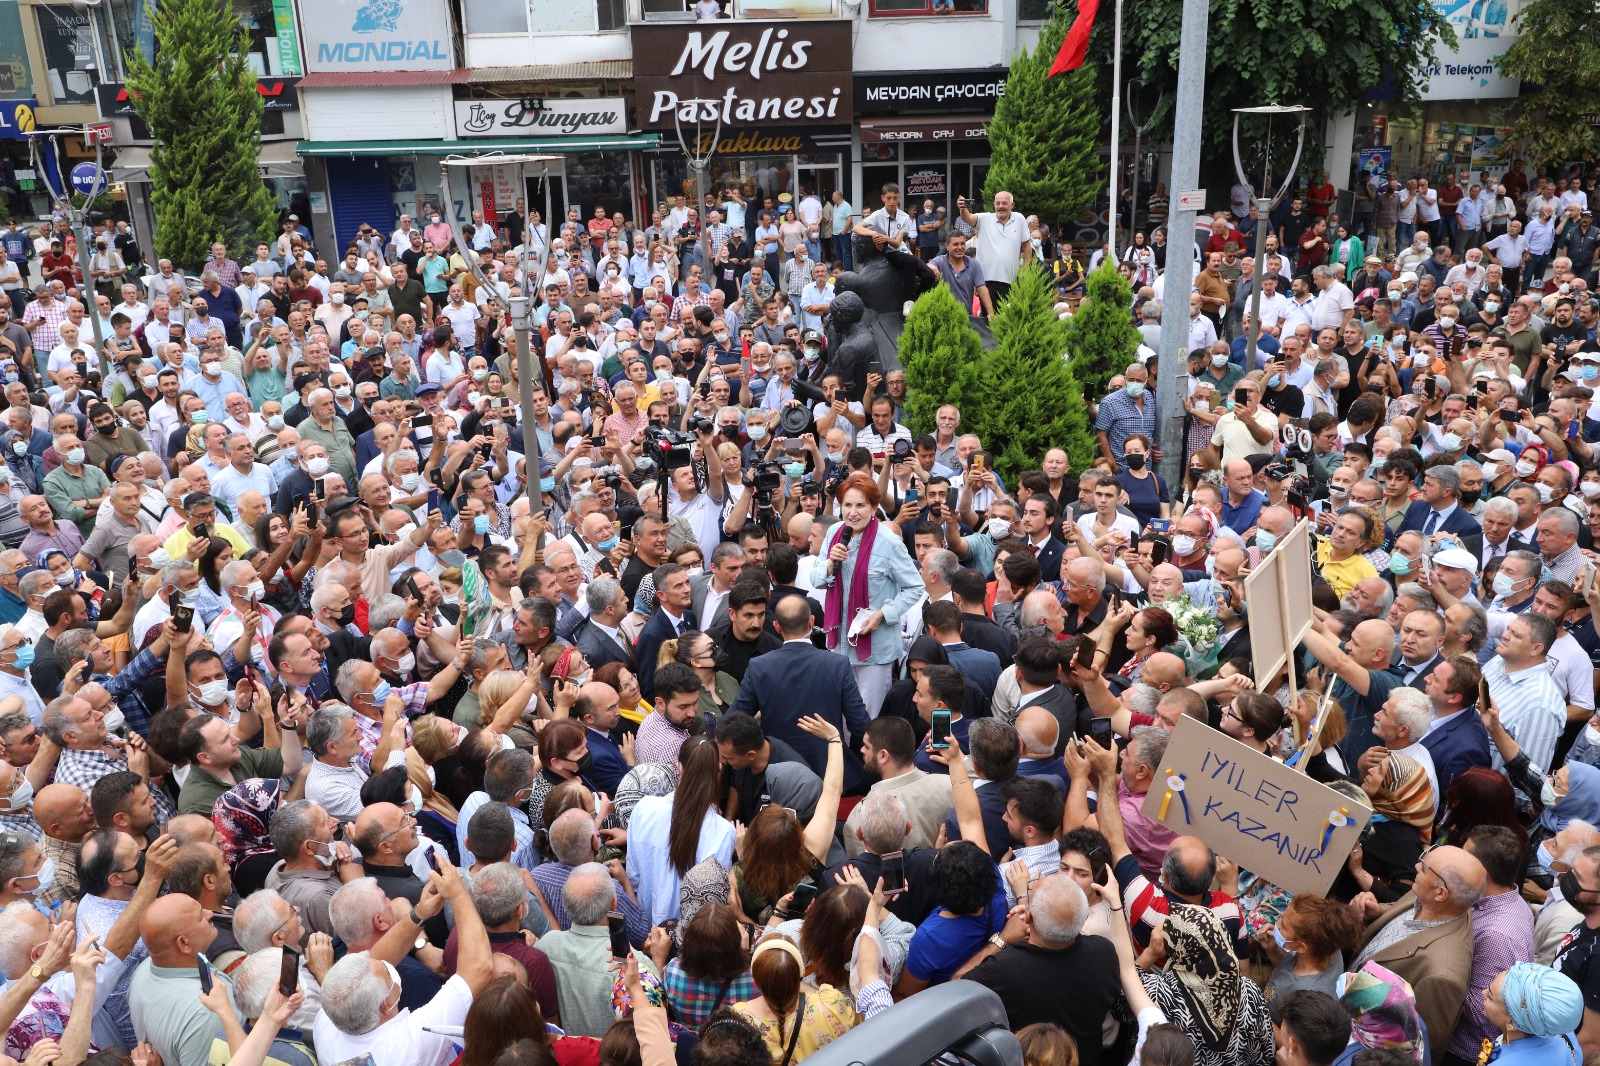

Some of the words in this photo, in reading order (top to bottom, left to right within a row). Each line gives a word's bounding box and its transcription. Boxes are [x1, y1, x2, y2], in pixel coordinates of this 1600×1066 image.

[670, 27, 812, 80] Melis
[1445, 64, 1492, 75] Telekom
[866, 85, 931, 101] MEYDAN
[934, 80, 1006, 102] ÇAYOCAĞ
[500, 101, 618, 133] Dünyası
[650, 87, 841, 125] Pastanesi
[692, 130, 803, 153] Baklava
[880, 131, 923, 140] MEYDAN
[933, 129, 955, 140] ÇAY
[965, 128, 988, 137] OCA
[1203, 796, 1321, 874] KAZANIR
